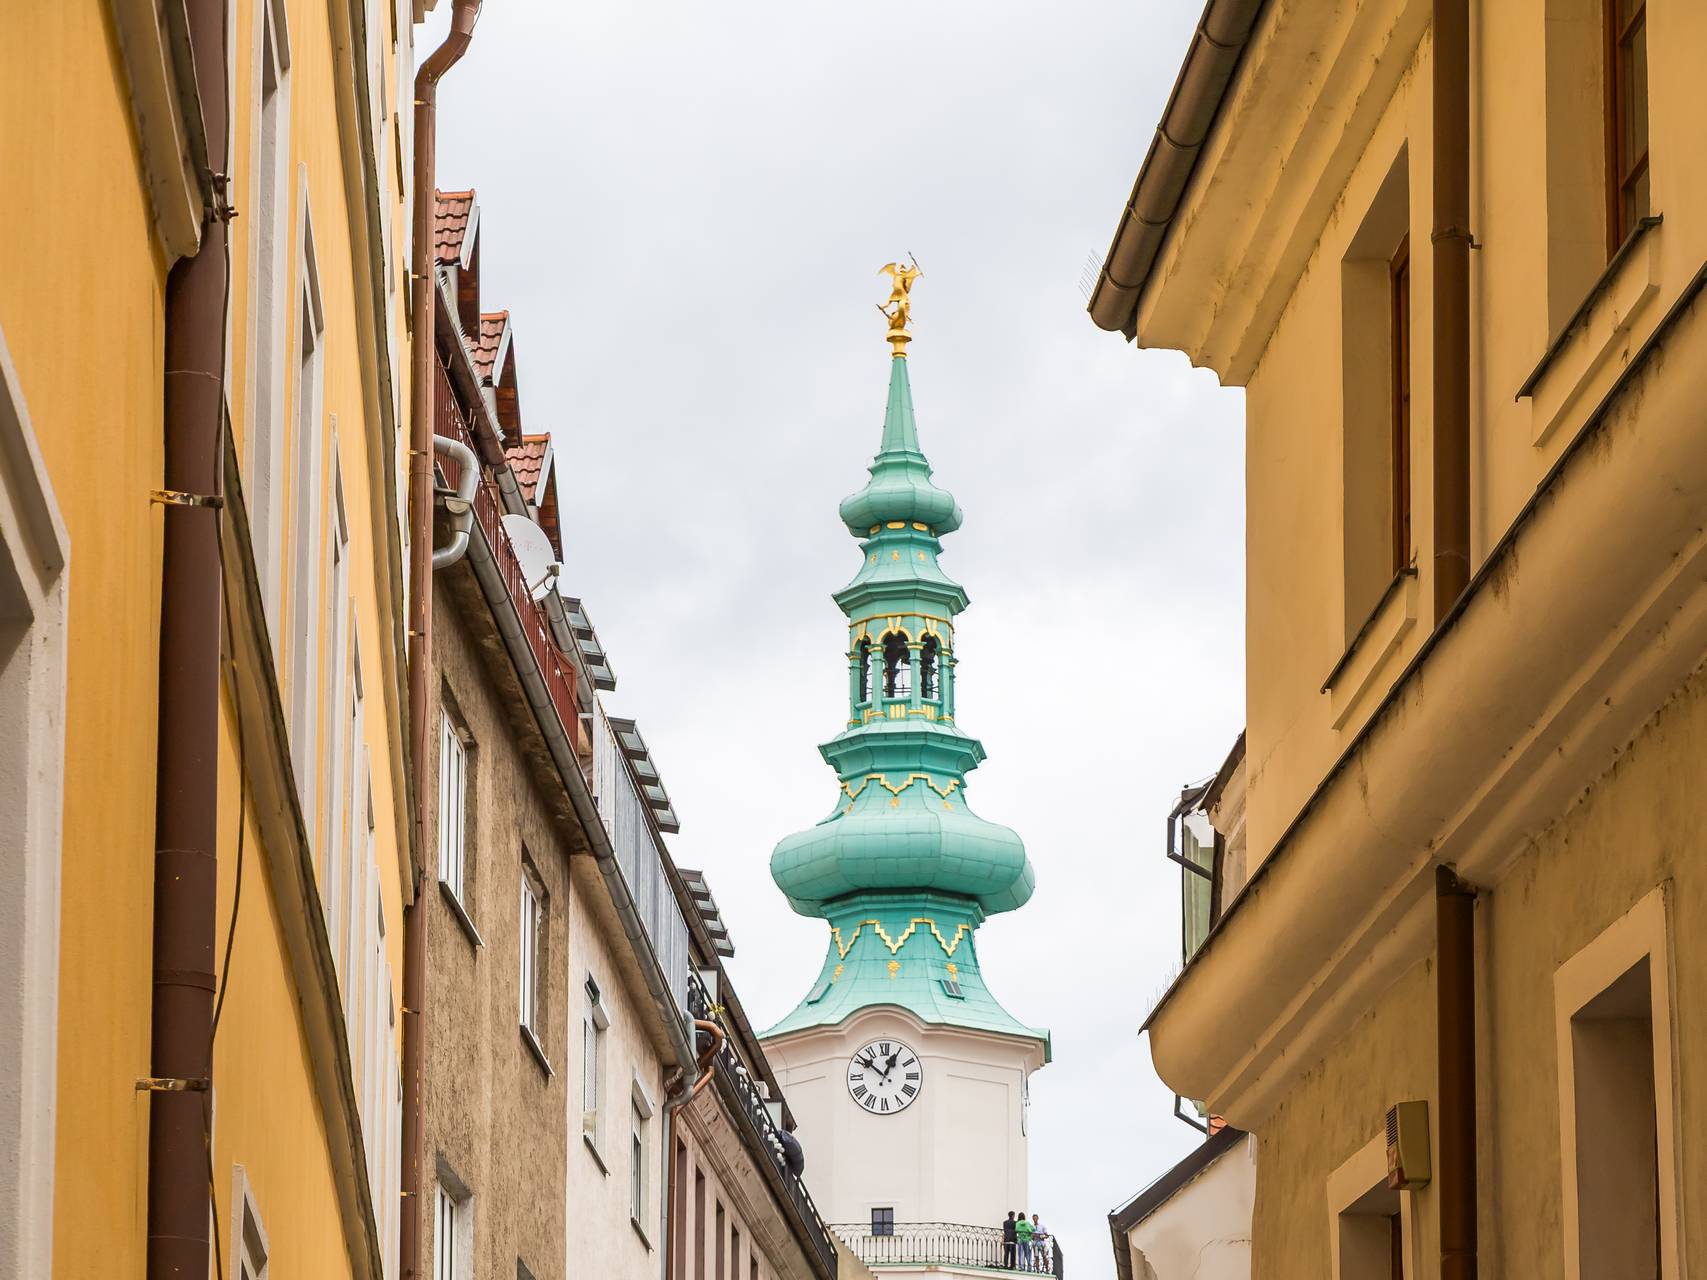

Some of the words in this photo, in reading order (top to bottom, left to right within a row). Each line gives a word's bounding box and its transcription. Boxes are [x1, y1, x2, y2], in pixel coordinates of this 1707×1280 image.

[865, 1046, 876, 1058] XI
[879, 1043, 890, 1056] XII
[902, 1057, 915, 1067] II
[906, 1072, 919, 1080] III
